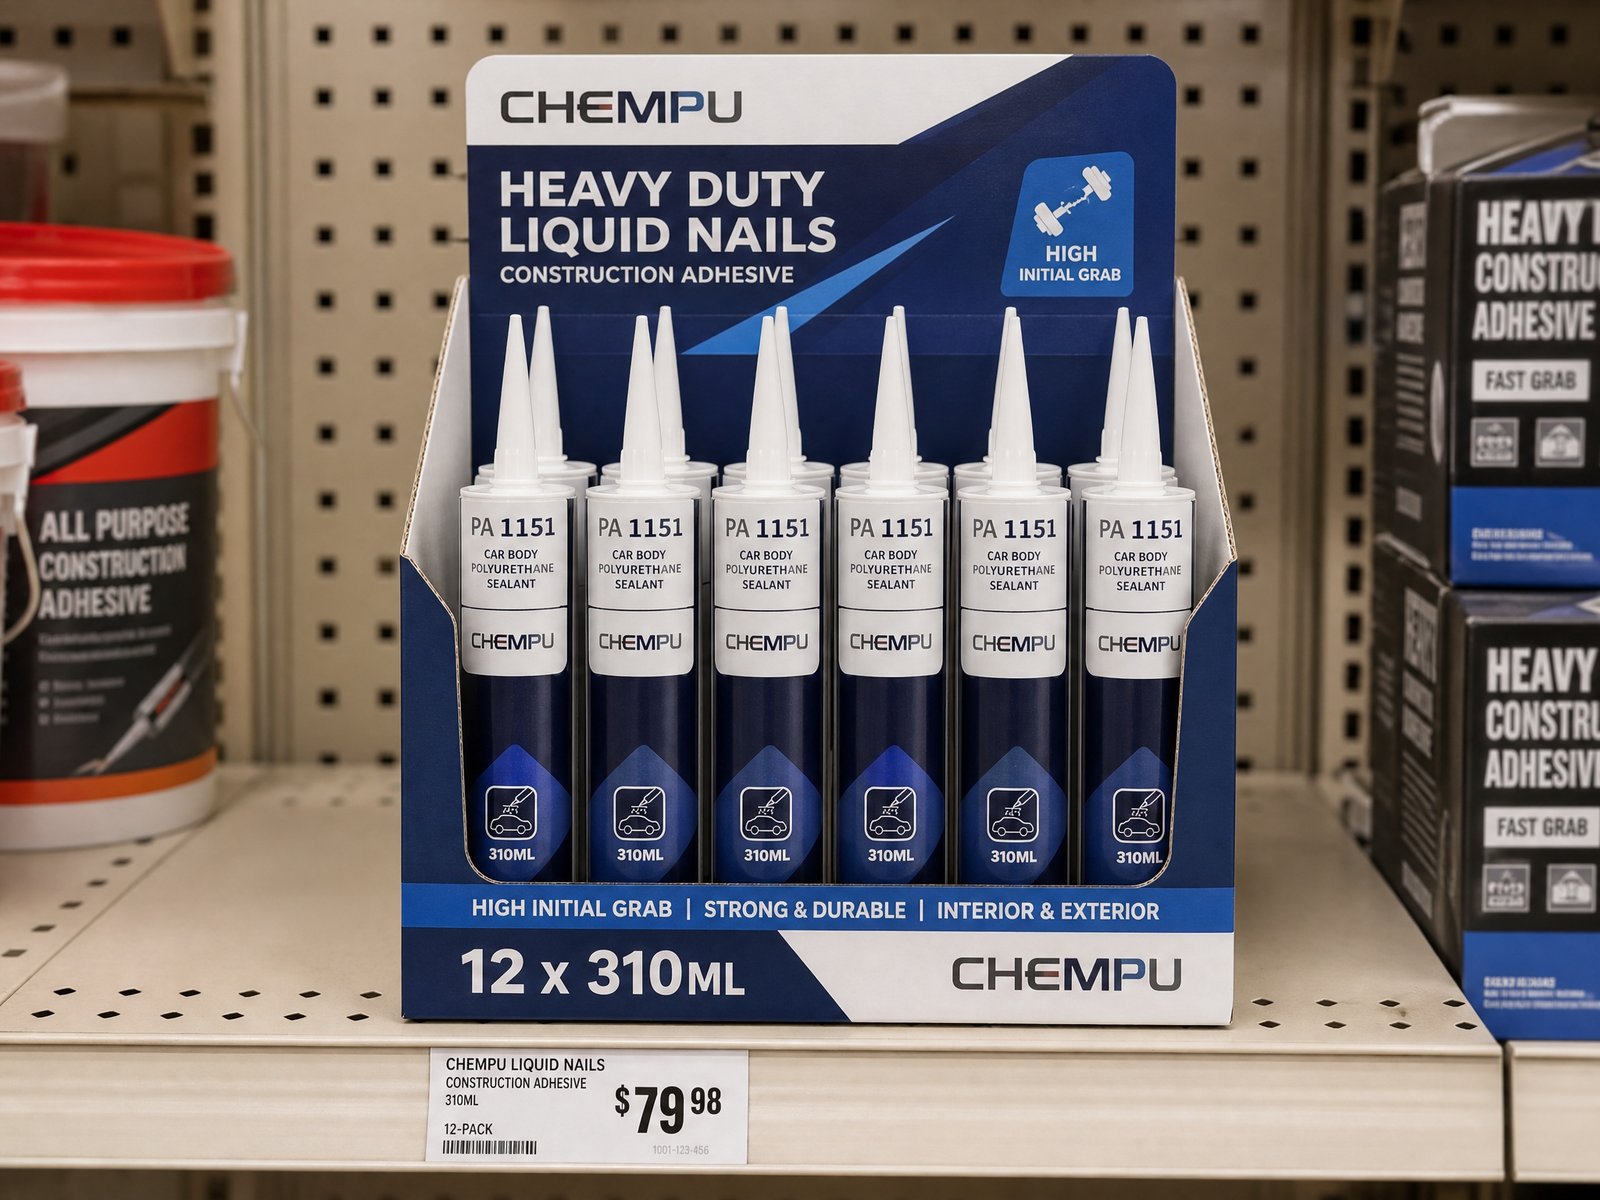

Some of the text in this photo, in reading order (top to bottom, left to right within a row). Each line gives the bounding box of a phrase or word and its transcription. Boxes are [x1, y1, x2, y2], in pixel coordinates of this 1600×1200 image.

[501, 91, 741, 123] CHEMPU
[501, 171, 824, 207] HEAVY DUTY
[1477, 200, 1585, 245] HEAVY
[501, 217, 836, 257] LIQUID NAILS
[1047, 246, 1096, 262] HIGH
[501, 266, 793, 283] CONSTRUCTION ADHESIVE
[1020, 268, 1121, 281] INITIAL GRAB
[1475, 252, 1600, 293] CONSTRU
[1472, 301, 1596, 340] ADHESIVE
[1486, 371, 1576, 390] FAST GRAB
[39, 502, 190, 543] ALL PURPOSE
[472, 517, 555, 537] PA 1151
[599, 518, 682, 537] PA 1151
[727, 518, 809, 538] PA 1151
[851, 518, 932, 537] PA 1151
[974, 519, 1056, 538] PA 1151
[1100, 520, 1182, 539] PA 1151
[485, 550, 537, 559] CAR BODY
[613, 550, 665, 559] CAR BODY
[740, 551, 792, 560] CAR BODY
[865, 550, 917, 559] CAR BODY
[988, 551, 1040, 561] CAR BODY
[1115, 552, 1167, 561] CAR BODY
[39, 543, 186, 581] CONSTRUCTION
[472, 563, 553, 574] POLYURETHANE
[599, 564, 681, 574] POLYURETHANE
[727, 564, 807, 574] POLYURETHANE
[851, 564, 931, 574] POLYURETHANE
[973, 565, 1054, 575] POLYURETHANE
[1100, 566, 1181, 576] POLYURETHANE
[488, 579, 535, 588] SEALANT
[616, 580, 662, 589] SEALANT
[743, 580, 791, 589] SEALANT
[868, 580, 913, 589] SEALANT
[990, 581, 1037, 590] SEALANT
[1117, 581, 1163, 591] SEALANT
[38, 584, 152, 619] ADHESIVE
[471, 633, 554, 650] CHEMPU
[600, 633, 681, 650] CHEMPU
[726, 634, 808, 651] CHEMPU
[851, 634, 931, 650] CHEMPU
[973, 635, 1055, 652] CHEMPU
[1099, 635, 1180, 652] CHEMPU
[1487, 647, 1597, 693] HEAVY
[1497, 817, 1589, 836] FAST GRAB
[489, 848, 535, 860] 310ML
[618, 849, 663, 861] 310ML
[745, 849, 790, 861] 310ML
[869, 849, 914, 861] 310ML
[992, 850, 1037, 863] 310ML
[1117, 851, 1163, 864] 310ML
[473, 899, 1159, 920] HIGH INITIAL GRAB STRONG & DURABLE INTERIOR & EXTERIOR
[462, 949, 524, 993] 12
[541, 962, 569, 994] x
[953, 957, 1181, 991] CHEMPU
[447, 1058, 604, 1072] CHEMPU LIQUID NAILS
[446, 1077, 586, 1089] CONSTRUCTION ADHESIVE
[446, 1094, 478, 1106] 310ML
[444, 1123, 492, 1135] 12-PACK
[653, 1145, 709, 1154] 1001-123-456
